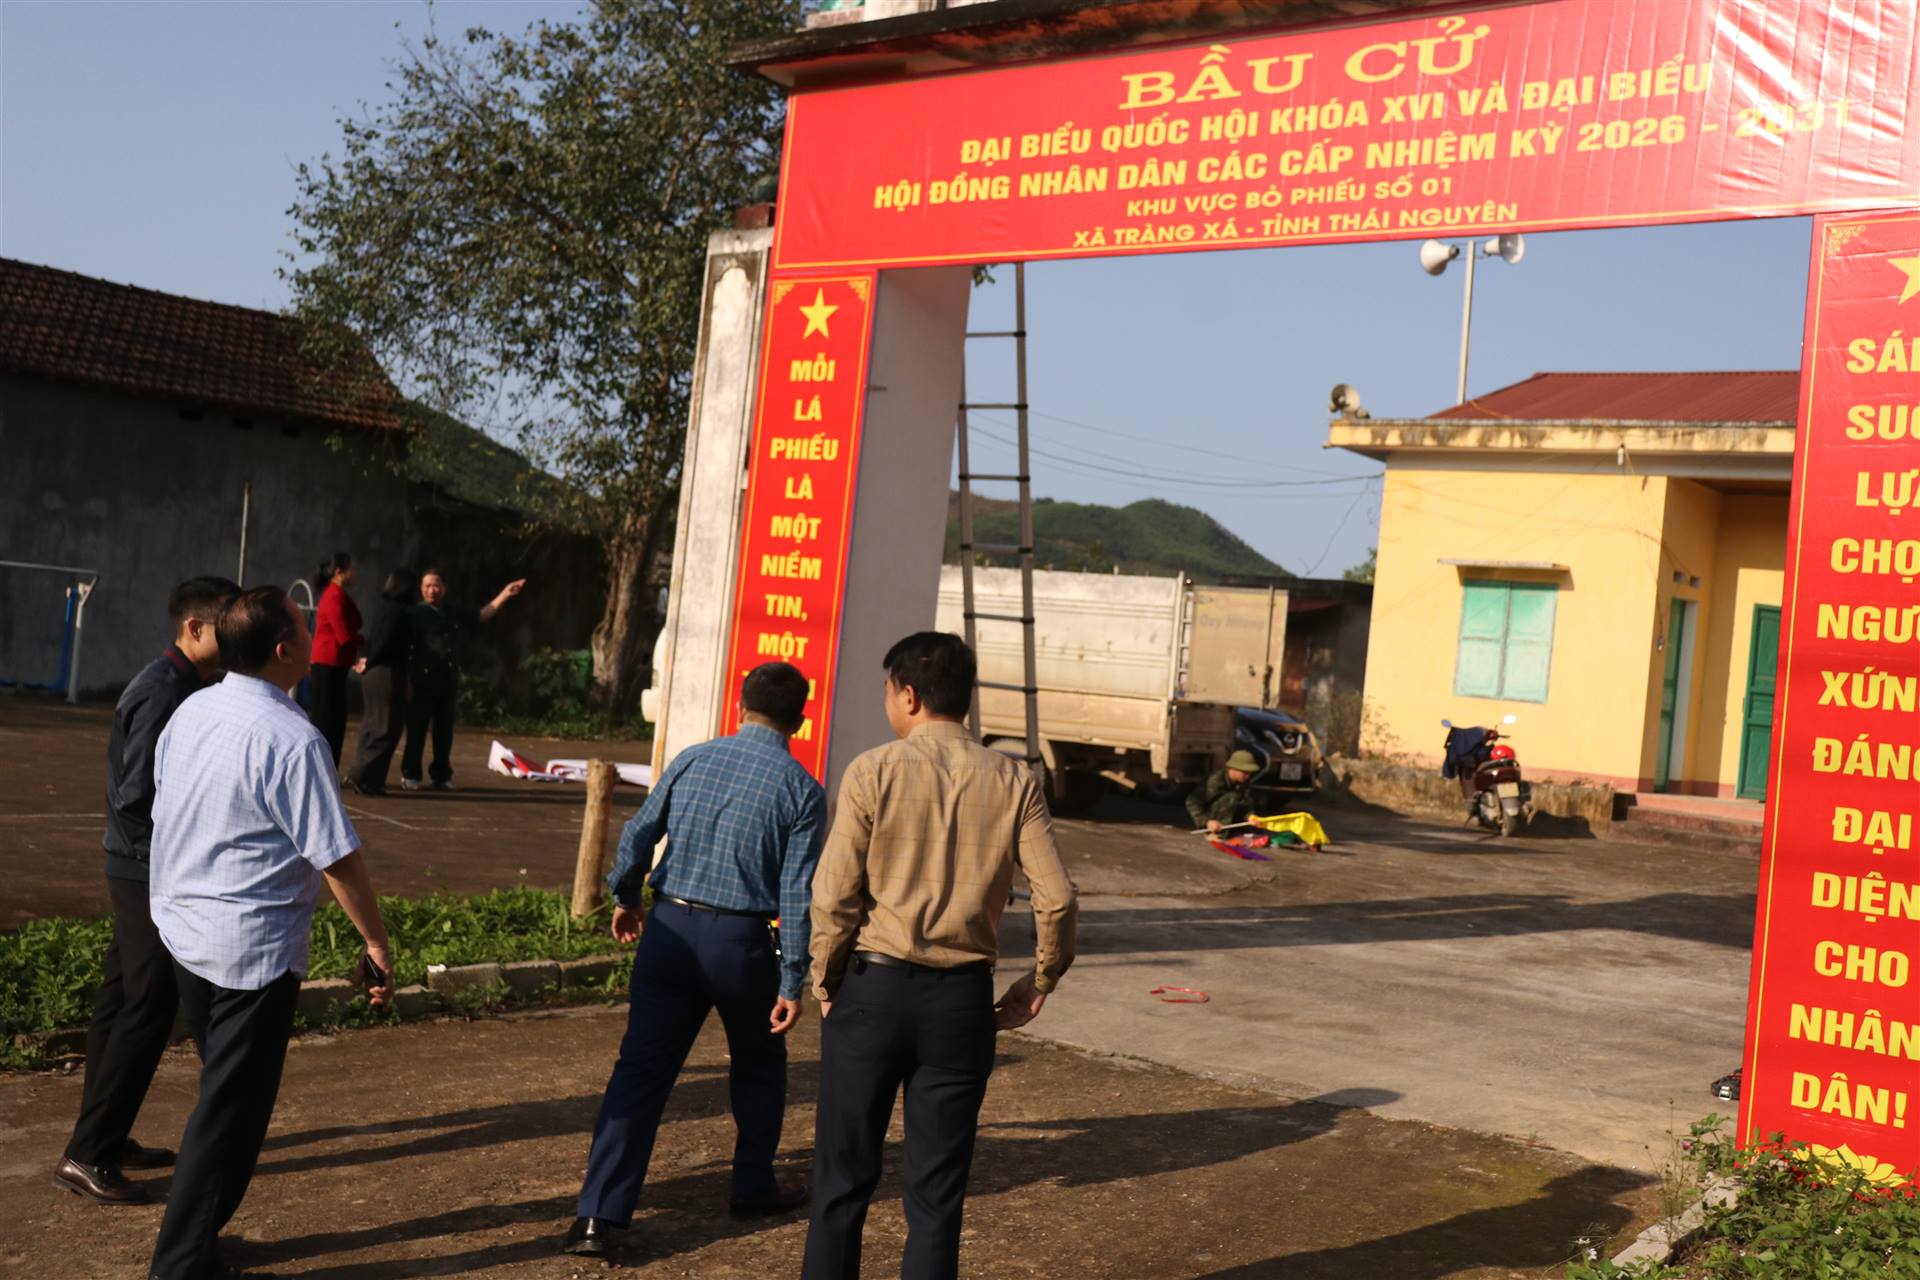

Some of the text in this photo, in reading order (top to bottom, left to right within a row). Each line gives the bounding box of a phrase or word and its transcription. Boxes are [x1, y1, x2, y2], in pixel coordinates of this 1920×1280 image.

[1119, 16, 1491, 110] BẦU CỬ
[960, 53, 1713, 167] ĐẠI BIỂU QUỐC HỘI KHÓA XVI VÀ ĐẠI BIỂU
[874, 180, 922, 212] HỘI
[929, 171, 1010, 205] ĐỒNG
[1018, 164, 1108, 197] NHÂN
[1117, 158, 1187, 189] DÂN
[1197, 150, 1267, 183] CÁC
[1279, 138, 1354, 176] CẤP
[1365, 130, 1496, 169] NHIỆM
[1510, 121, 1564, 158] KỲ
[1577, 114, 1686, 151] 2026
[1127, 172, 1452, 217] KHU VỰC BỎ PHIẾU SỐ 01
[1073, 227, 1106, 247] XÃ
[1114, 223, 1195, 246] TRÀNG
[1202, 217, 1239, 239] XÁ
[1261, 212, 1320, 236] TỈNH
[1328, 207, 1390, 231] THÁI
[1399, 199, 1518, 227] NGUYÊN
[789, 353, 836, 382] MỖI
[794, 395, 822, 421] LÁ
[769, 433, 838, 460] PHIẾU
[785, 473, 813, 500] LÀ
[1856, 468, 1920, 516] LỰ
[770, 512, 821, 544] MỘT
[765, 594, 808, 622] TIN,
[1816, 603, 1920, 643] NGƯ
[757, 631, 809, 662] MỘT
[1817, 666, 1920, 712] XỨN
[1812, 733, 1920, 783] ĐÁN
[1832, 805, 1912, 855] ĐẠI
[1811, 871, 1920, 923] DIỆN
[1814, 940, 1909, 988] CHO
[1789, 1003, 1920, 1061] NHÂN
[1790, 1071, 1908, 1129] DÂN!
